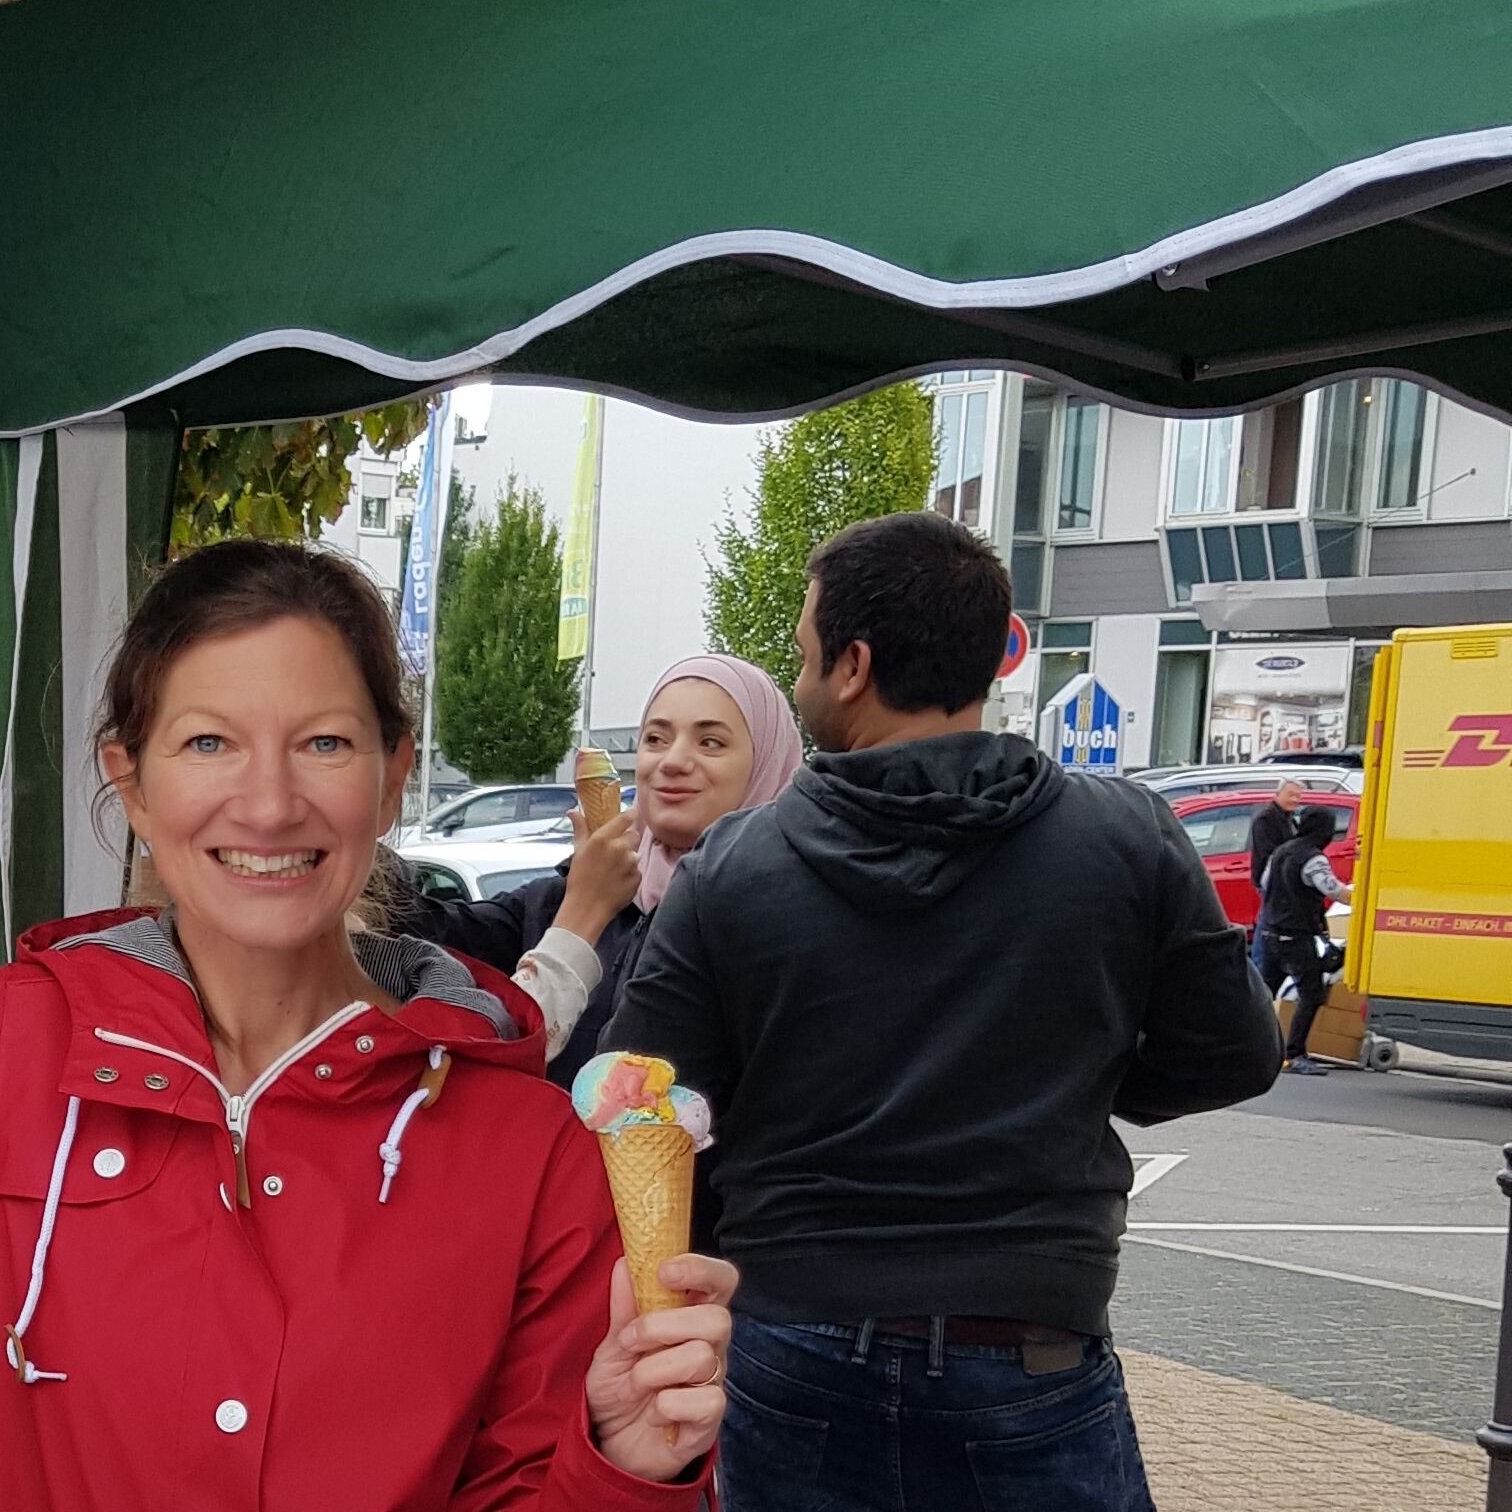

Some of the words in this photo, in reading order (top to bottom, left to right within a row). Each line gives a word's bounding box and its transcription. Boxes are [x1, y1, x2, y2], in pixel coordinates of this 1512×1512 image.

[1063, 722, 1117, 748] buch
[1440, 714, 1512, 767] D
[1386, 915, 1407, 928] DHL
[1409, 916, 1444, 930] PAKET
